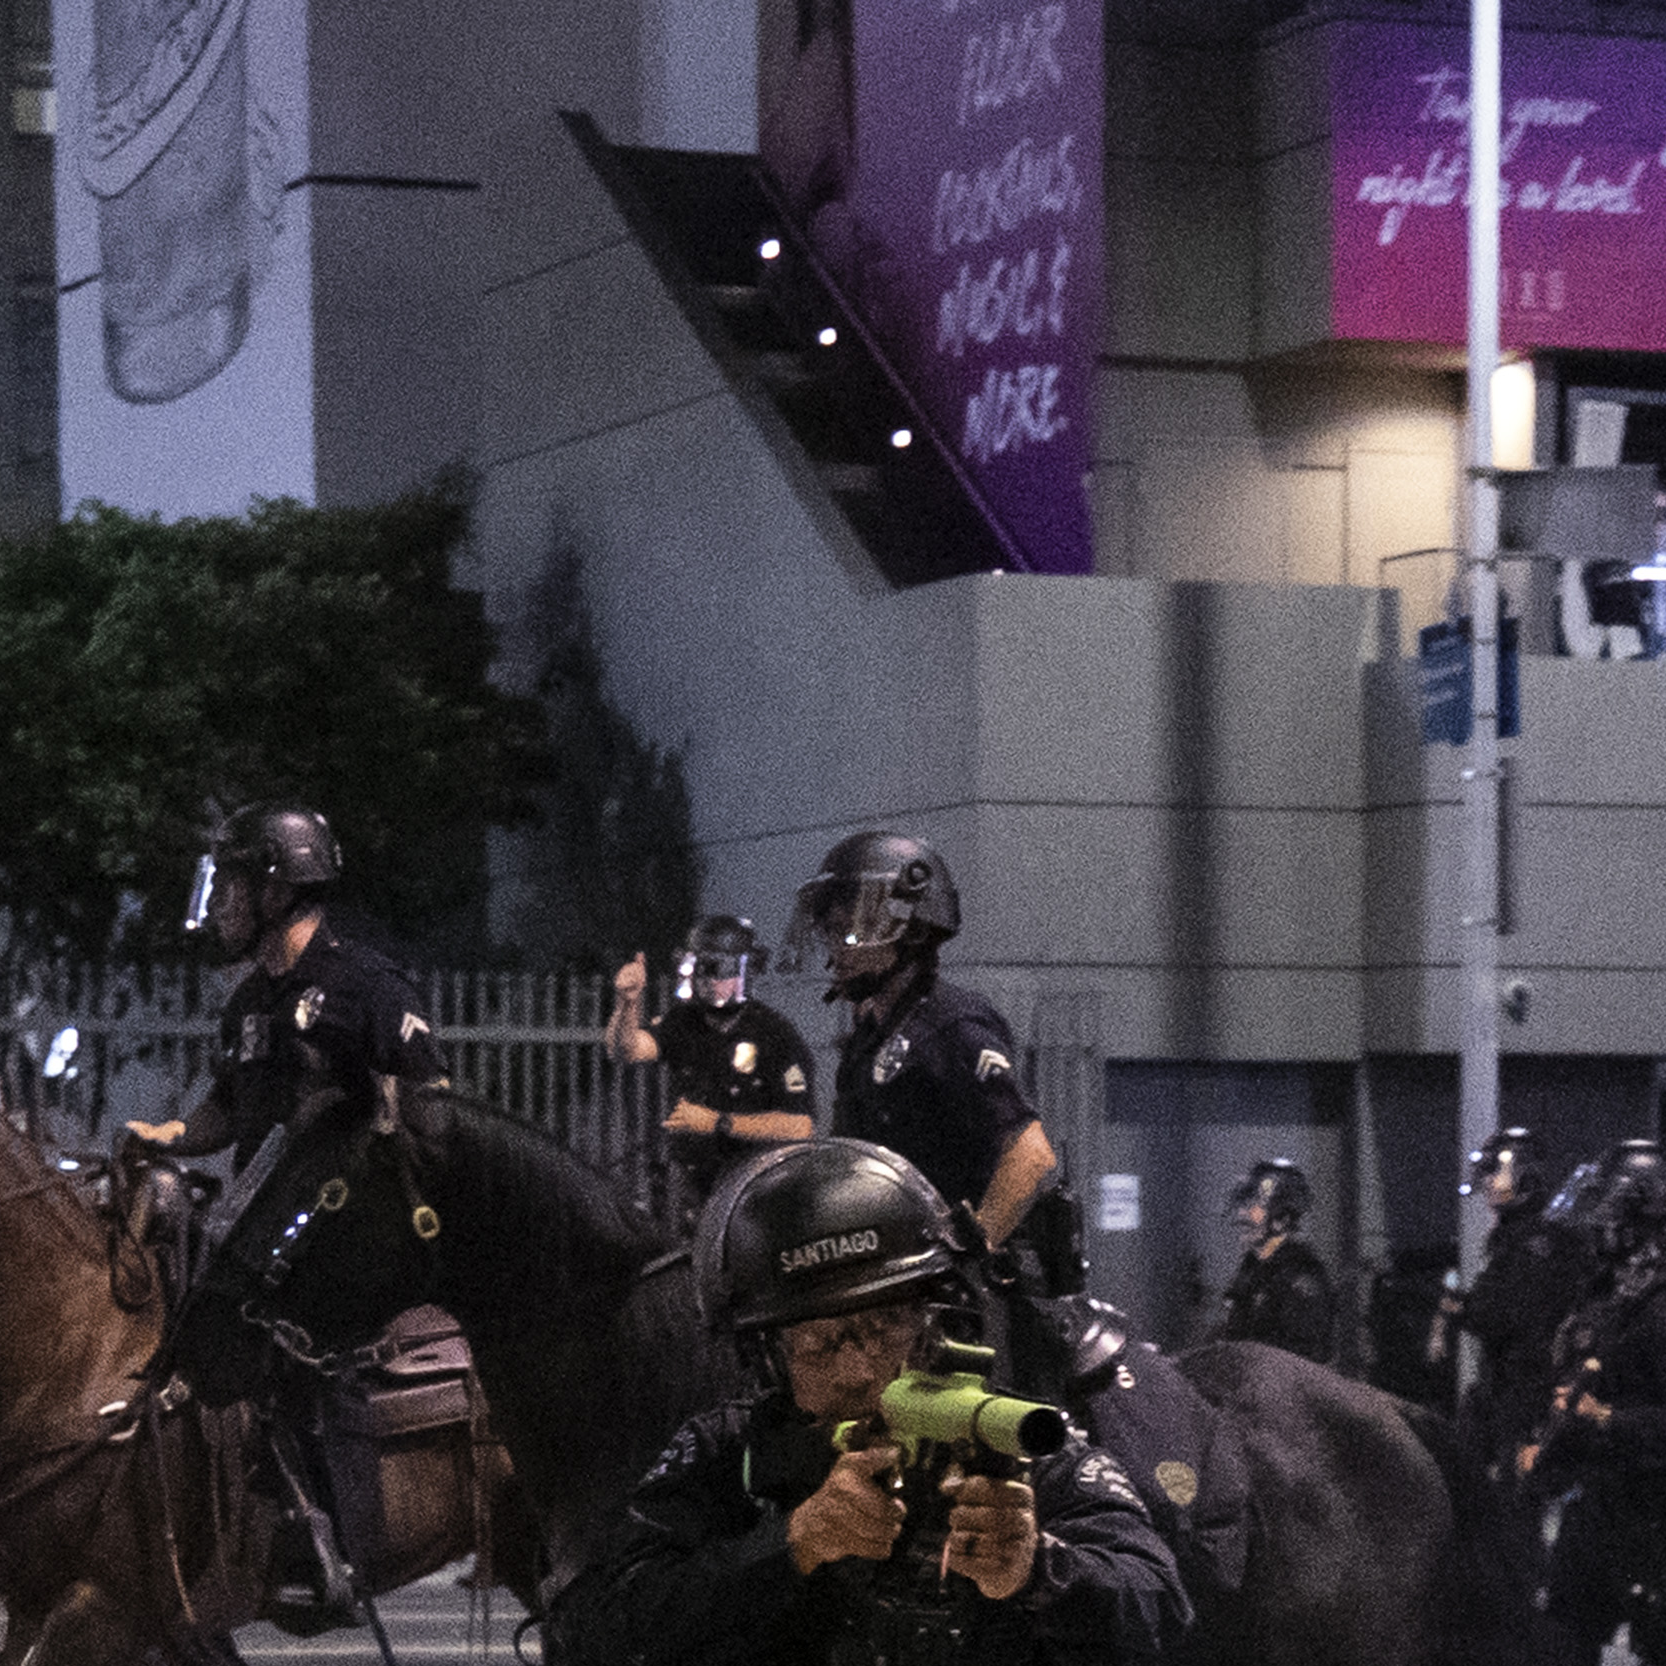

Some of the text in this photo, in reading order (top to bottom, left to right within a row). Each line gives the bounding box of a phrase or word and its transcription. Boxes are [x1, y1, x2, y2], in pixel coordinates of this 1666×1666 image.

[1499, 97, 1600, 166] your
[1356, 150, 1468, 247] night
[779, 1229, 880, 1273] SANTIAGO
